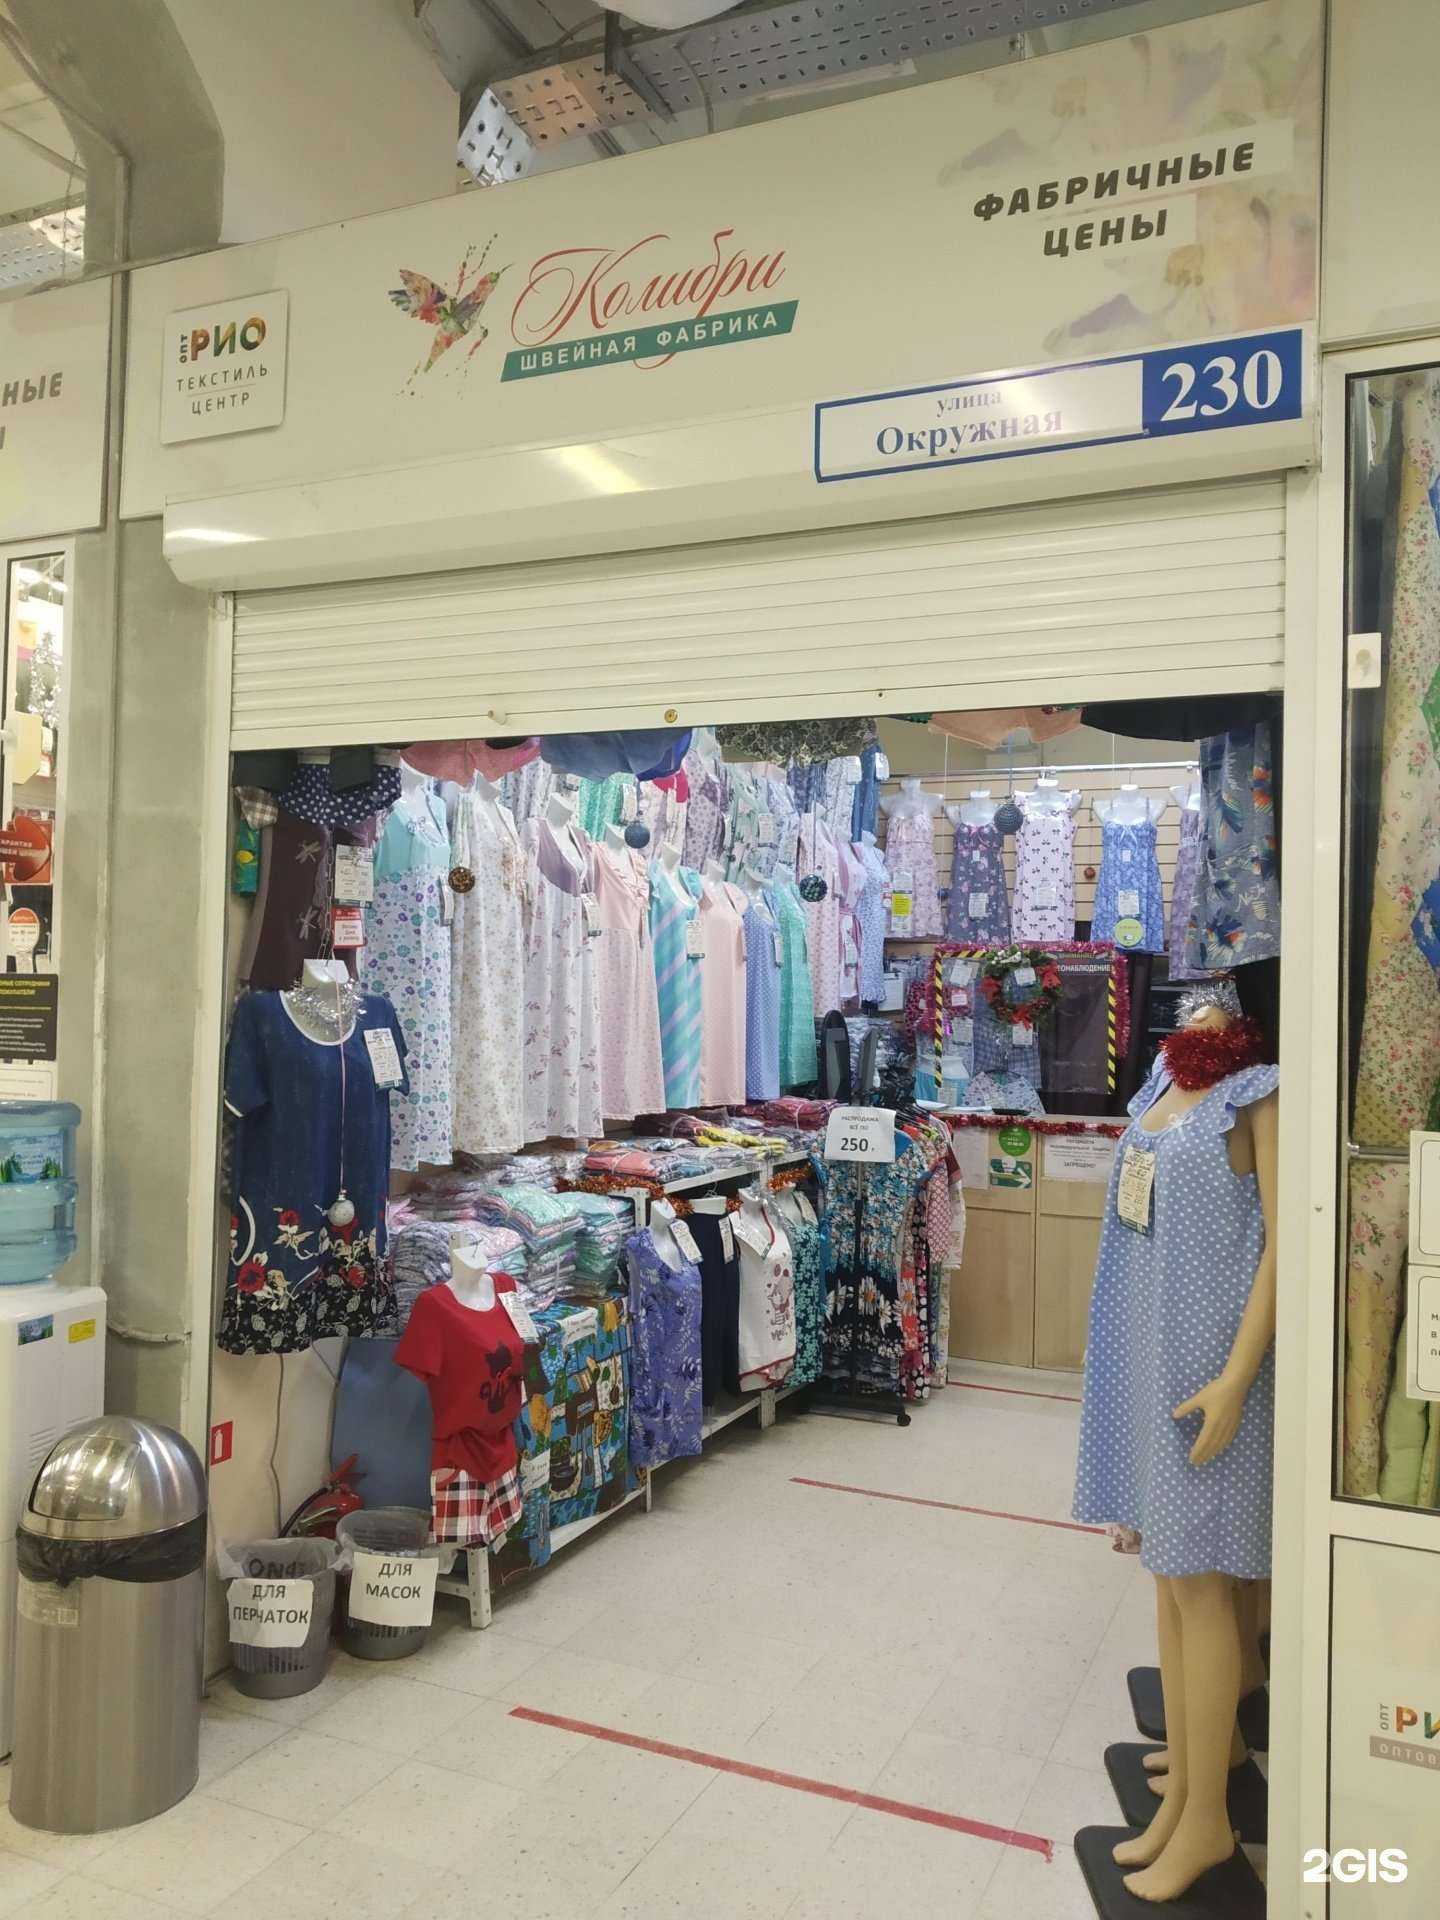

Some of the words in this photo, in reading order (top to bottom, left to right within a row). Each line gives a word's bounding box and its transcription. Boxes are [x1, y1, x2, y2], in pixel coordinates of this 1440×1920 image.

[973, 142, 1255, 221] ФАБРИЧНЫЕ
[1043, 209, 1168, 258] ЦЕНЫ
[511, 229, 787, 360] Колибри
[190, 317, 267, 362] РИО
[520, 336, 637, 371] ШВЕЙНАЯ
[656, 310, 778, 346] ФАБРИКА
[1, 371, 64, 408] НЫЕ
[176, 364, 268, 392] ТЕКСТИЛЬ
[1160, 350, 1284, 422] 230
[191, 391, 250, 416] ЦЕНТР
[935, 387, 1003, 418] улица
[876, 410, 1064, 458] Окружная
[840, 1137, 869, 1152] 250
[378, 1562, 413, 1577] ДЛЯ
[252, 1584, 287, 1601] ДЛЯ
[365, 1583, 422, 1599] МАСОК
[232, 1606, 309, 1624] ПЕРЧАТОК
[1379, 1743, 1437, 1766] ОПТОВ
